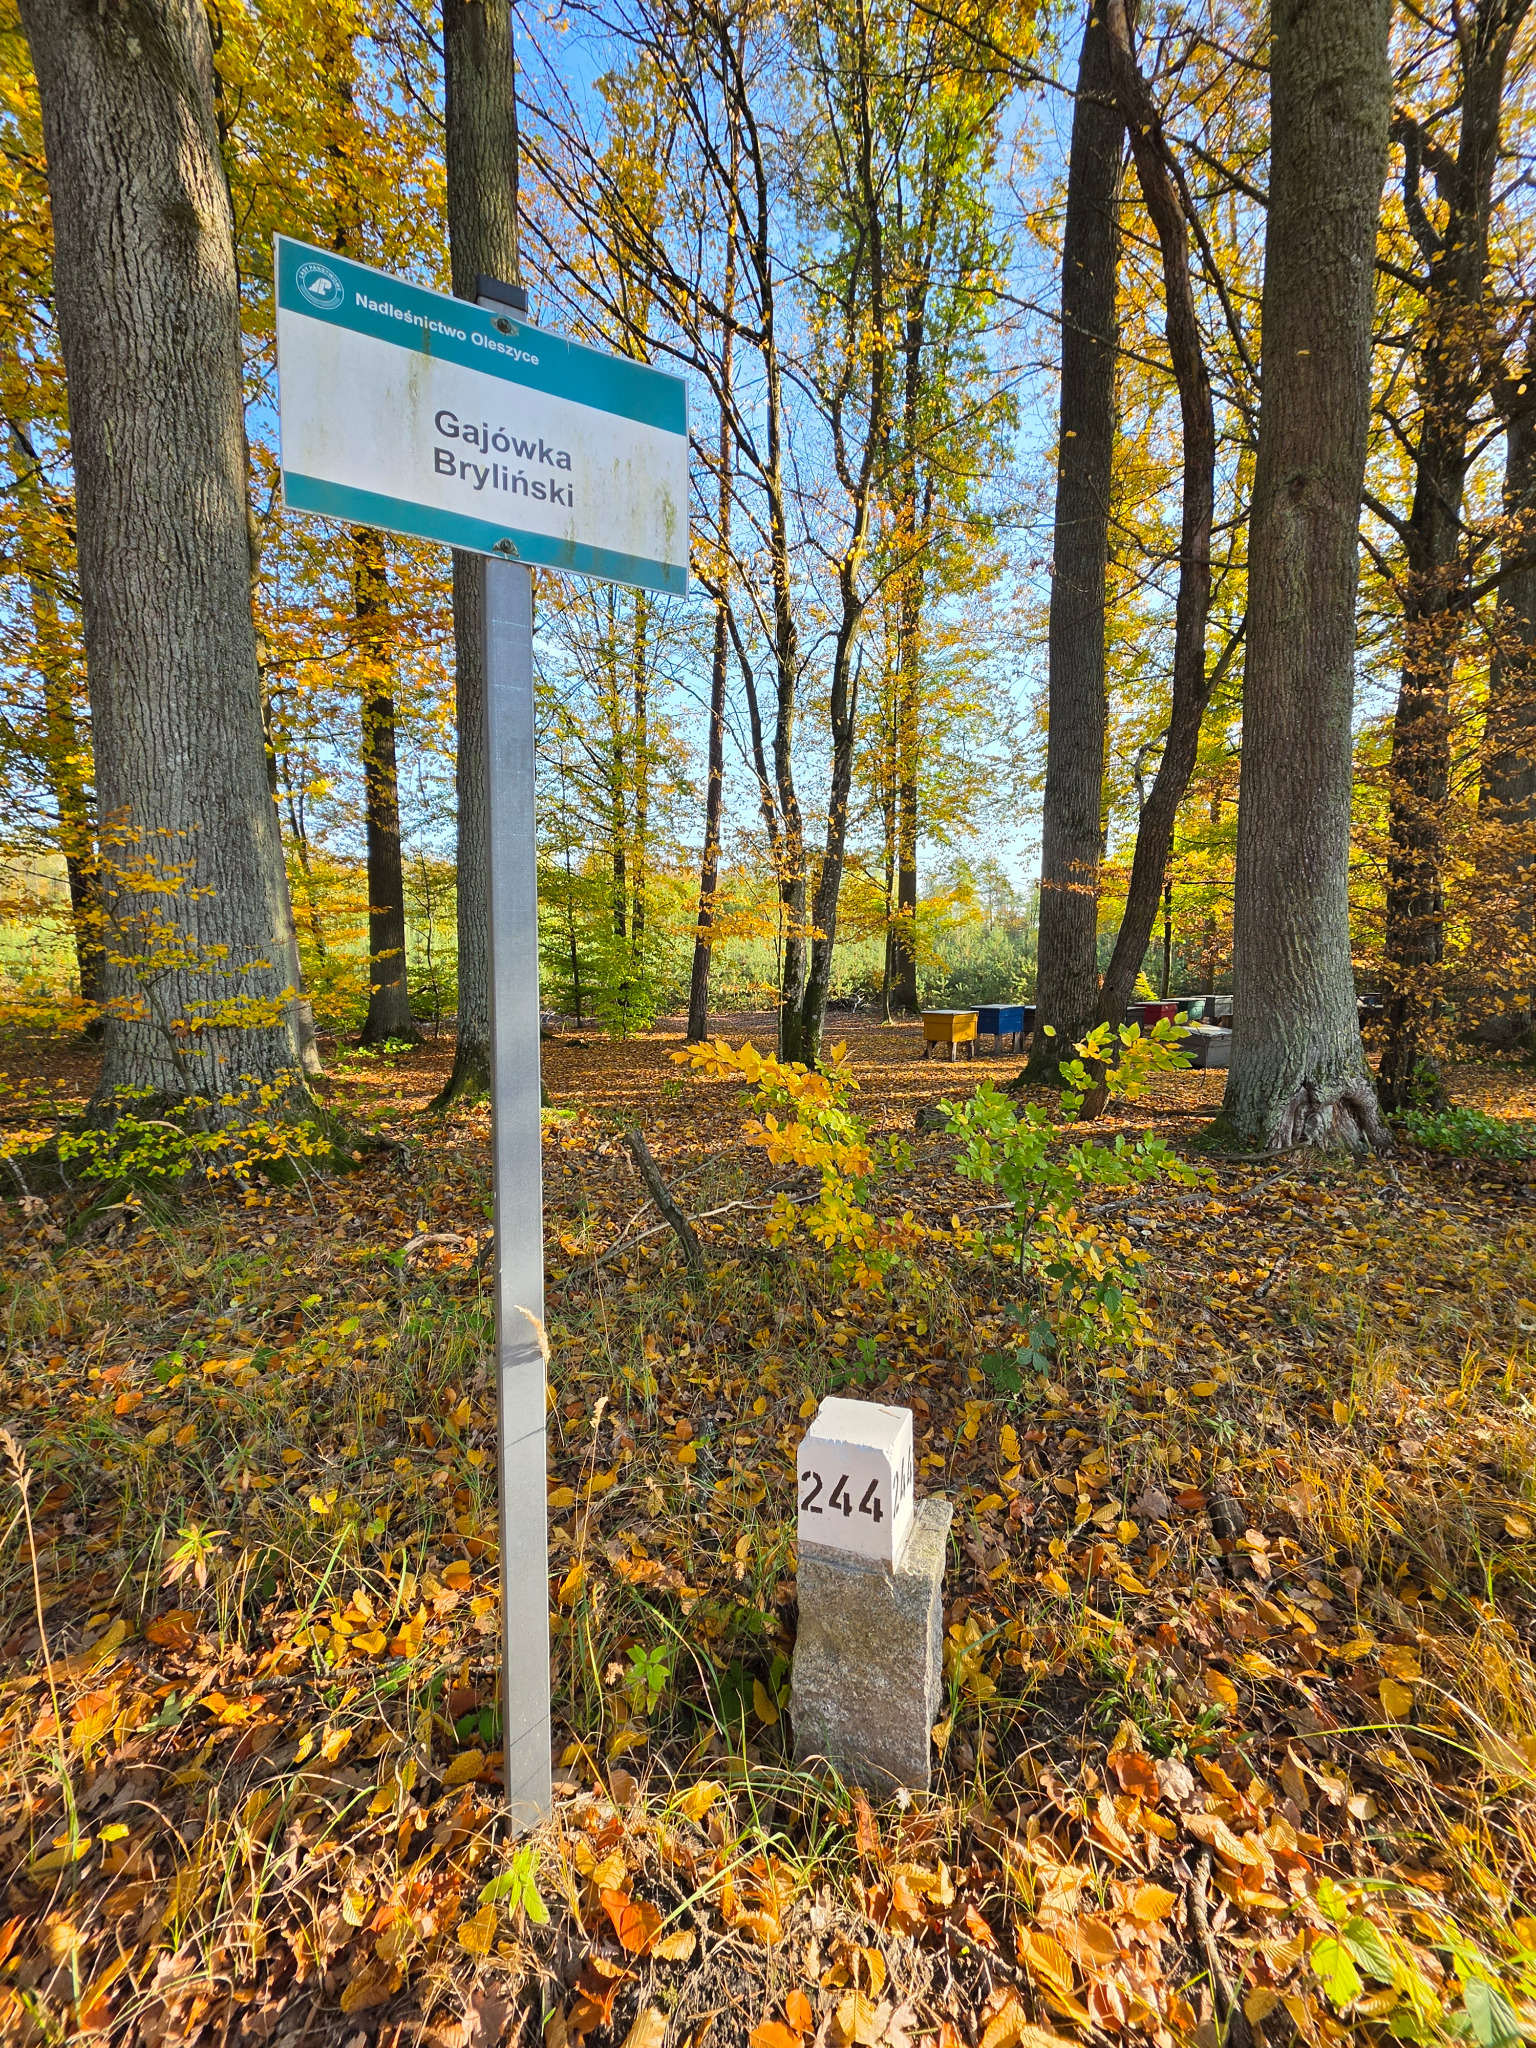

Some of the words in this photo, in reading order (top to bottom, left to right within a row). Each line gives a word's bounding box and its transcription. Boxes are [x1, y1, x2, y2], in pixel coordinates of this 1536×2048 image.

[355, 291, 467, 341] Nadleśnictwo
[471, 332, 540, 366] Oleszyce
[434, 410, 572, 471] Gajówka
[434, 447, 573, 507] Bryliński
[800, 1471, 883, 1523] 244
